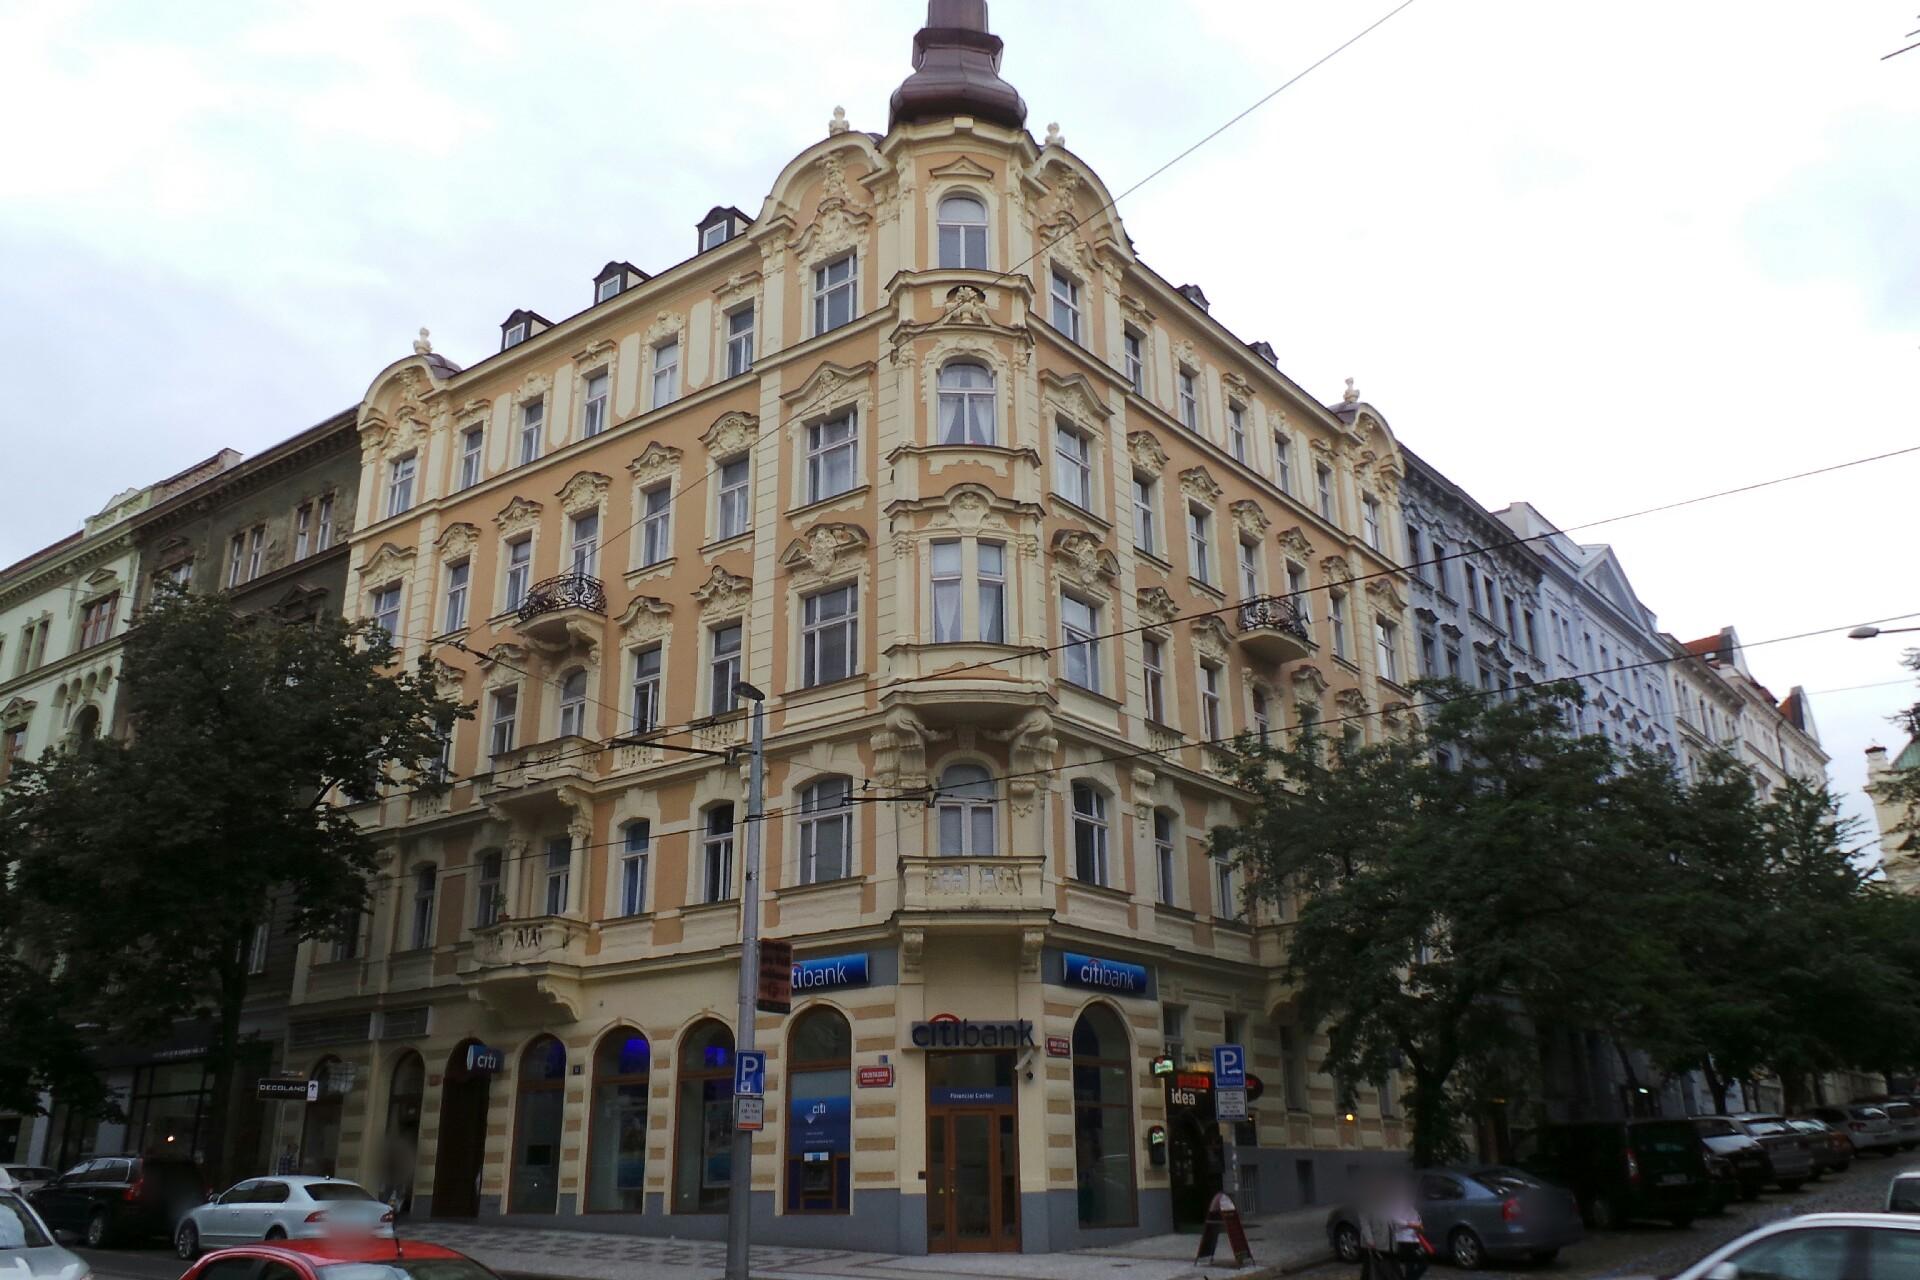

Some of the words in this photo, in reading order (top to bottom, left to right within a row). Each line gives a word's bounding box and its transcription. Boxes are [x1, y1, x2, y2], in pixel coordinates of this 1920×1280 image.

[1080, 963, 1134, 990] citibank
[911, 1018, 1035, 1047] citibank
[477, 1055, 496, 1069] citi
[741, 1056, 759, 1081] P
[1220, 1050, 1237, 1075] P
[259, 1084, 306, 1092] DECOLAND
[1171, 1088, 1196, 1105] idea
[812, 1103, 826, 1114] citi
